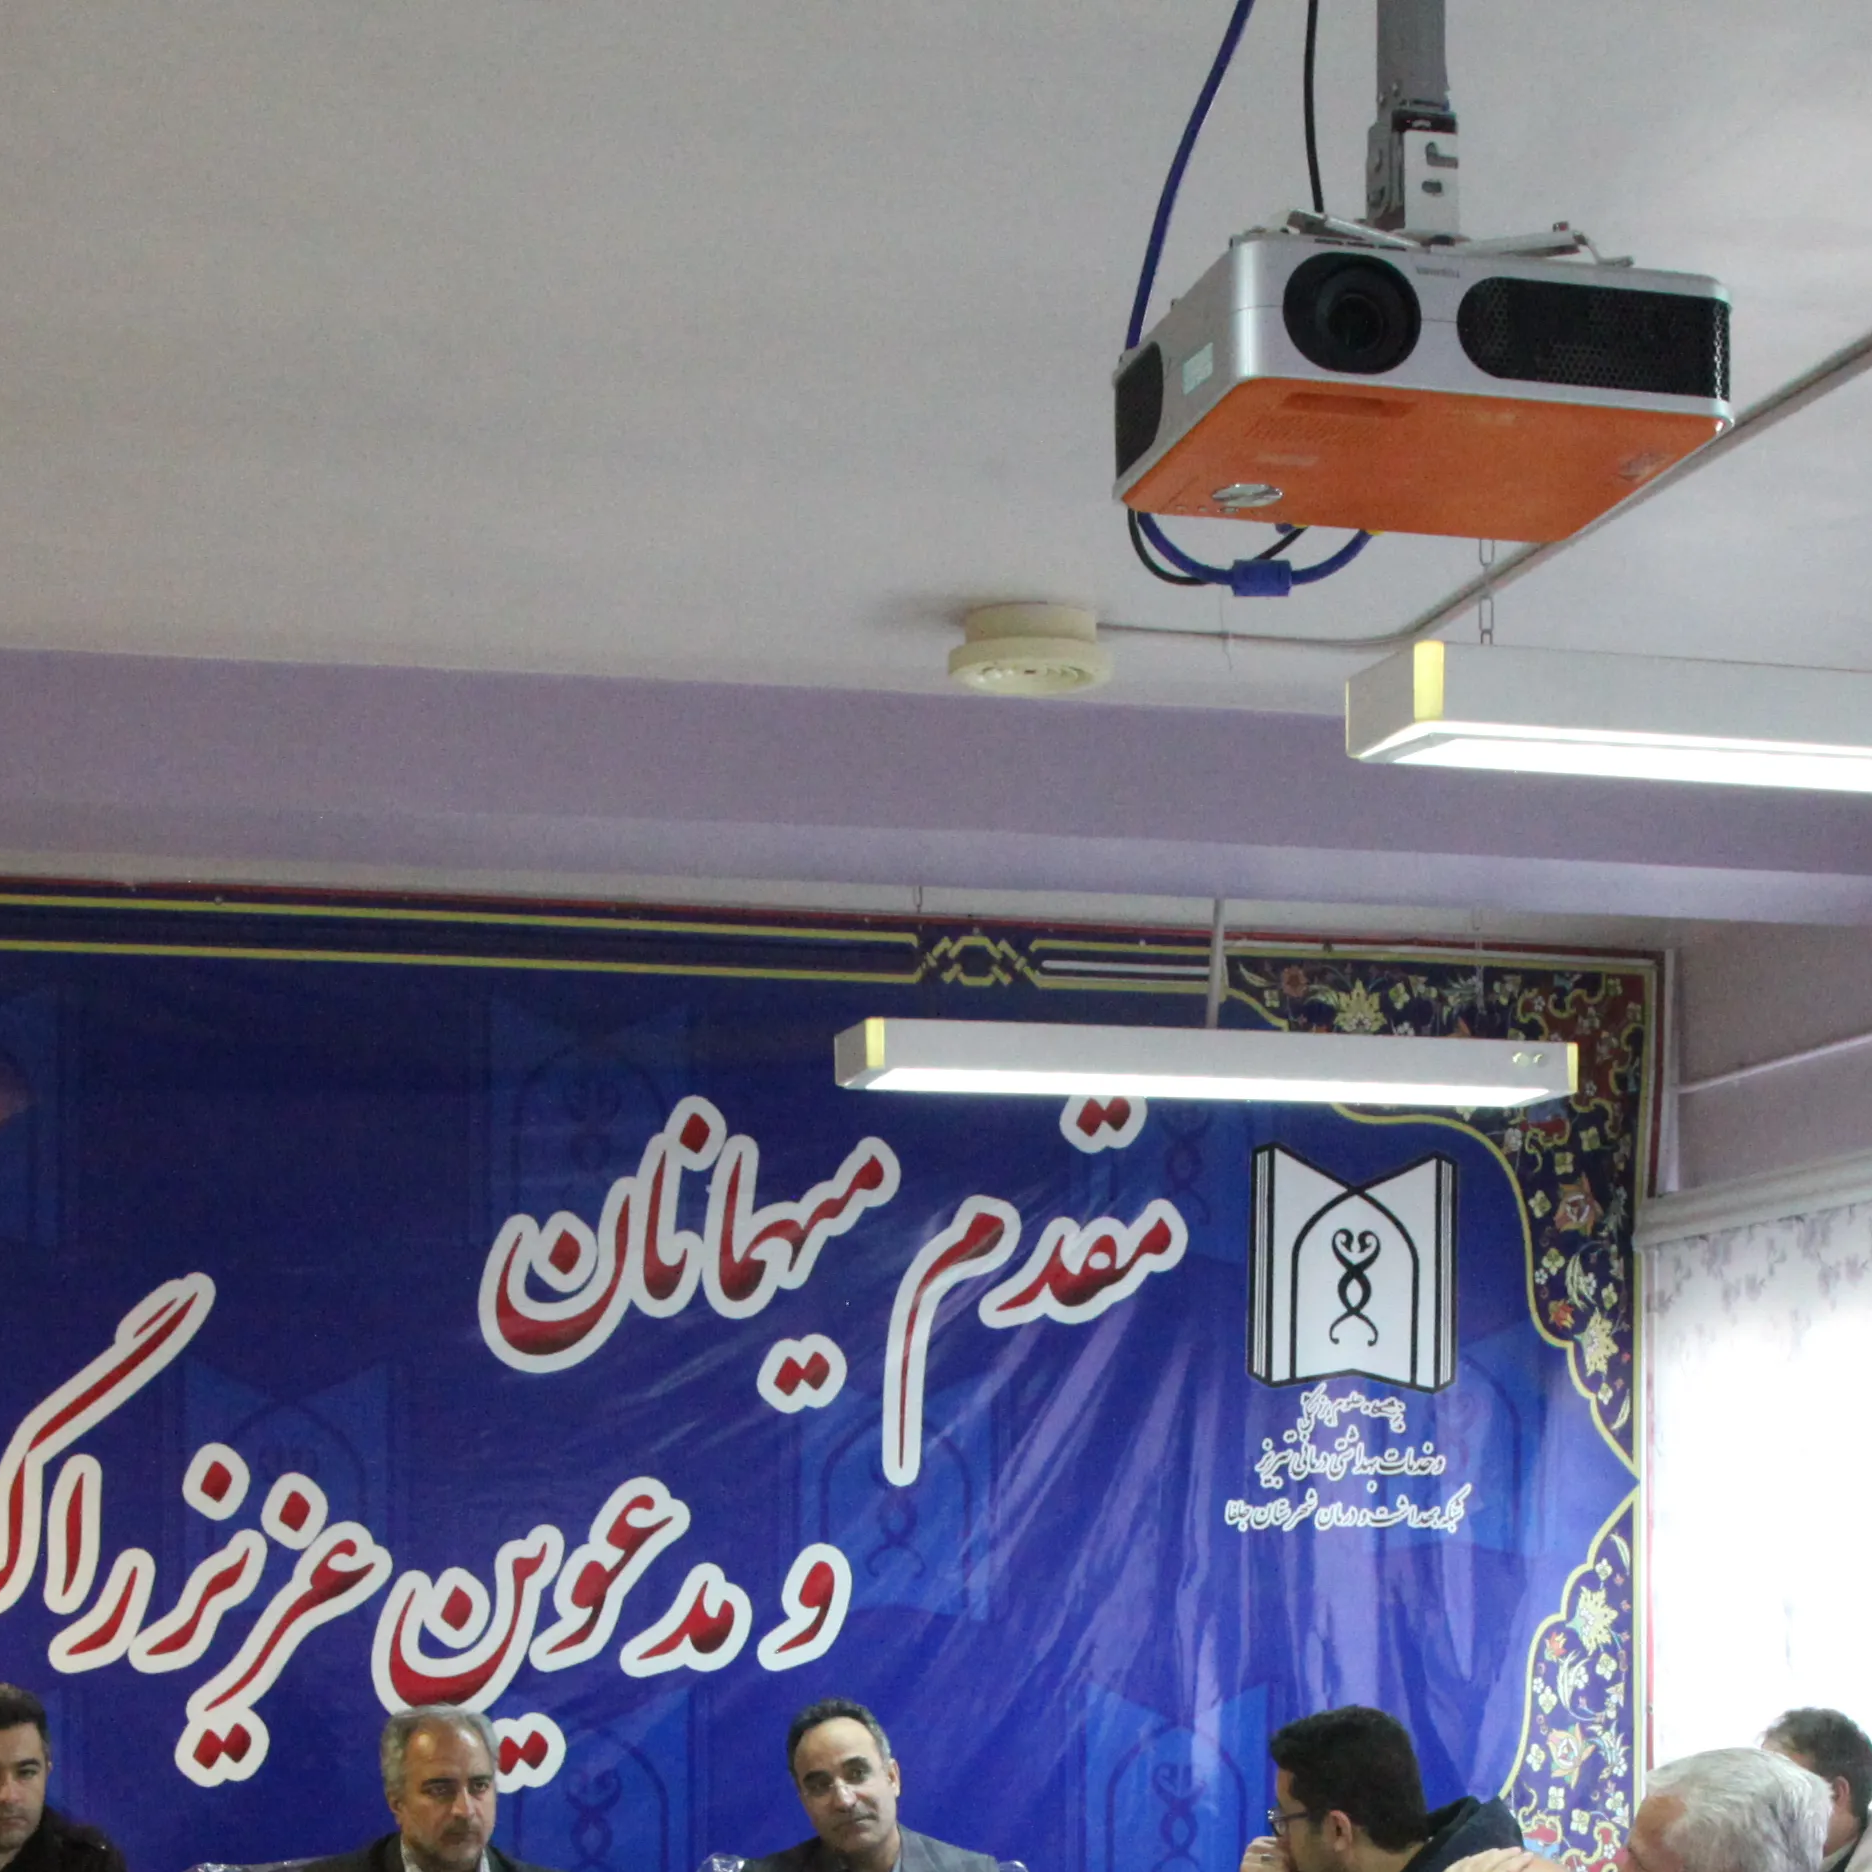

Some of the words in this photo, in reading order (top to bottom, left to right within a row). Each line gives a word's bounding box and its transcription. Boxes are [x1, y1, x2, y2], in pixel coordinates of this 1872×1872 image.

[883, 1096, 1188, 1486] مقدم
[1254, 1430, 1297, 1488] تبریز
[371, 1476, 753, 1793] مدعوین
[757, 1543, 852, 1672] و
